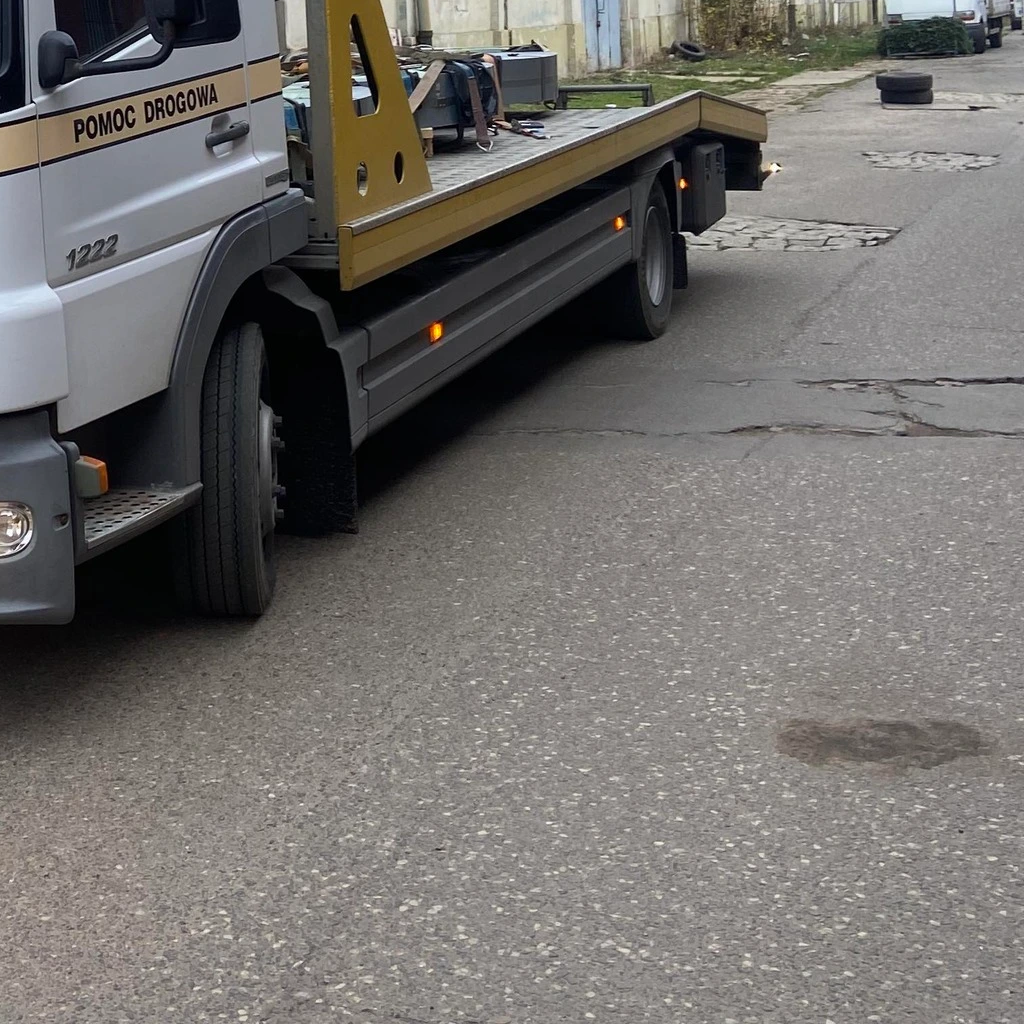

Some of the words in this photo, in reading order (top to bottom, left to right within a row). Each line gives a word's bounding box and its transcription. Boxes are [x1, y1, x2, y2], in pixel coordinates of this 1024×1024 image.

[73, 104, 136, 144] POMOC
[143, 83, 219, 124] DROGOWA
[65, 233, 119, 272] 1222
